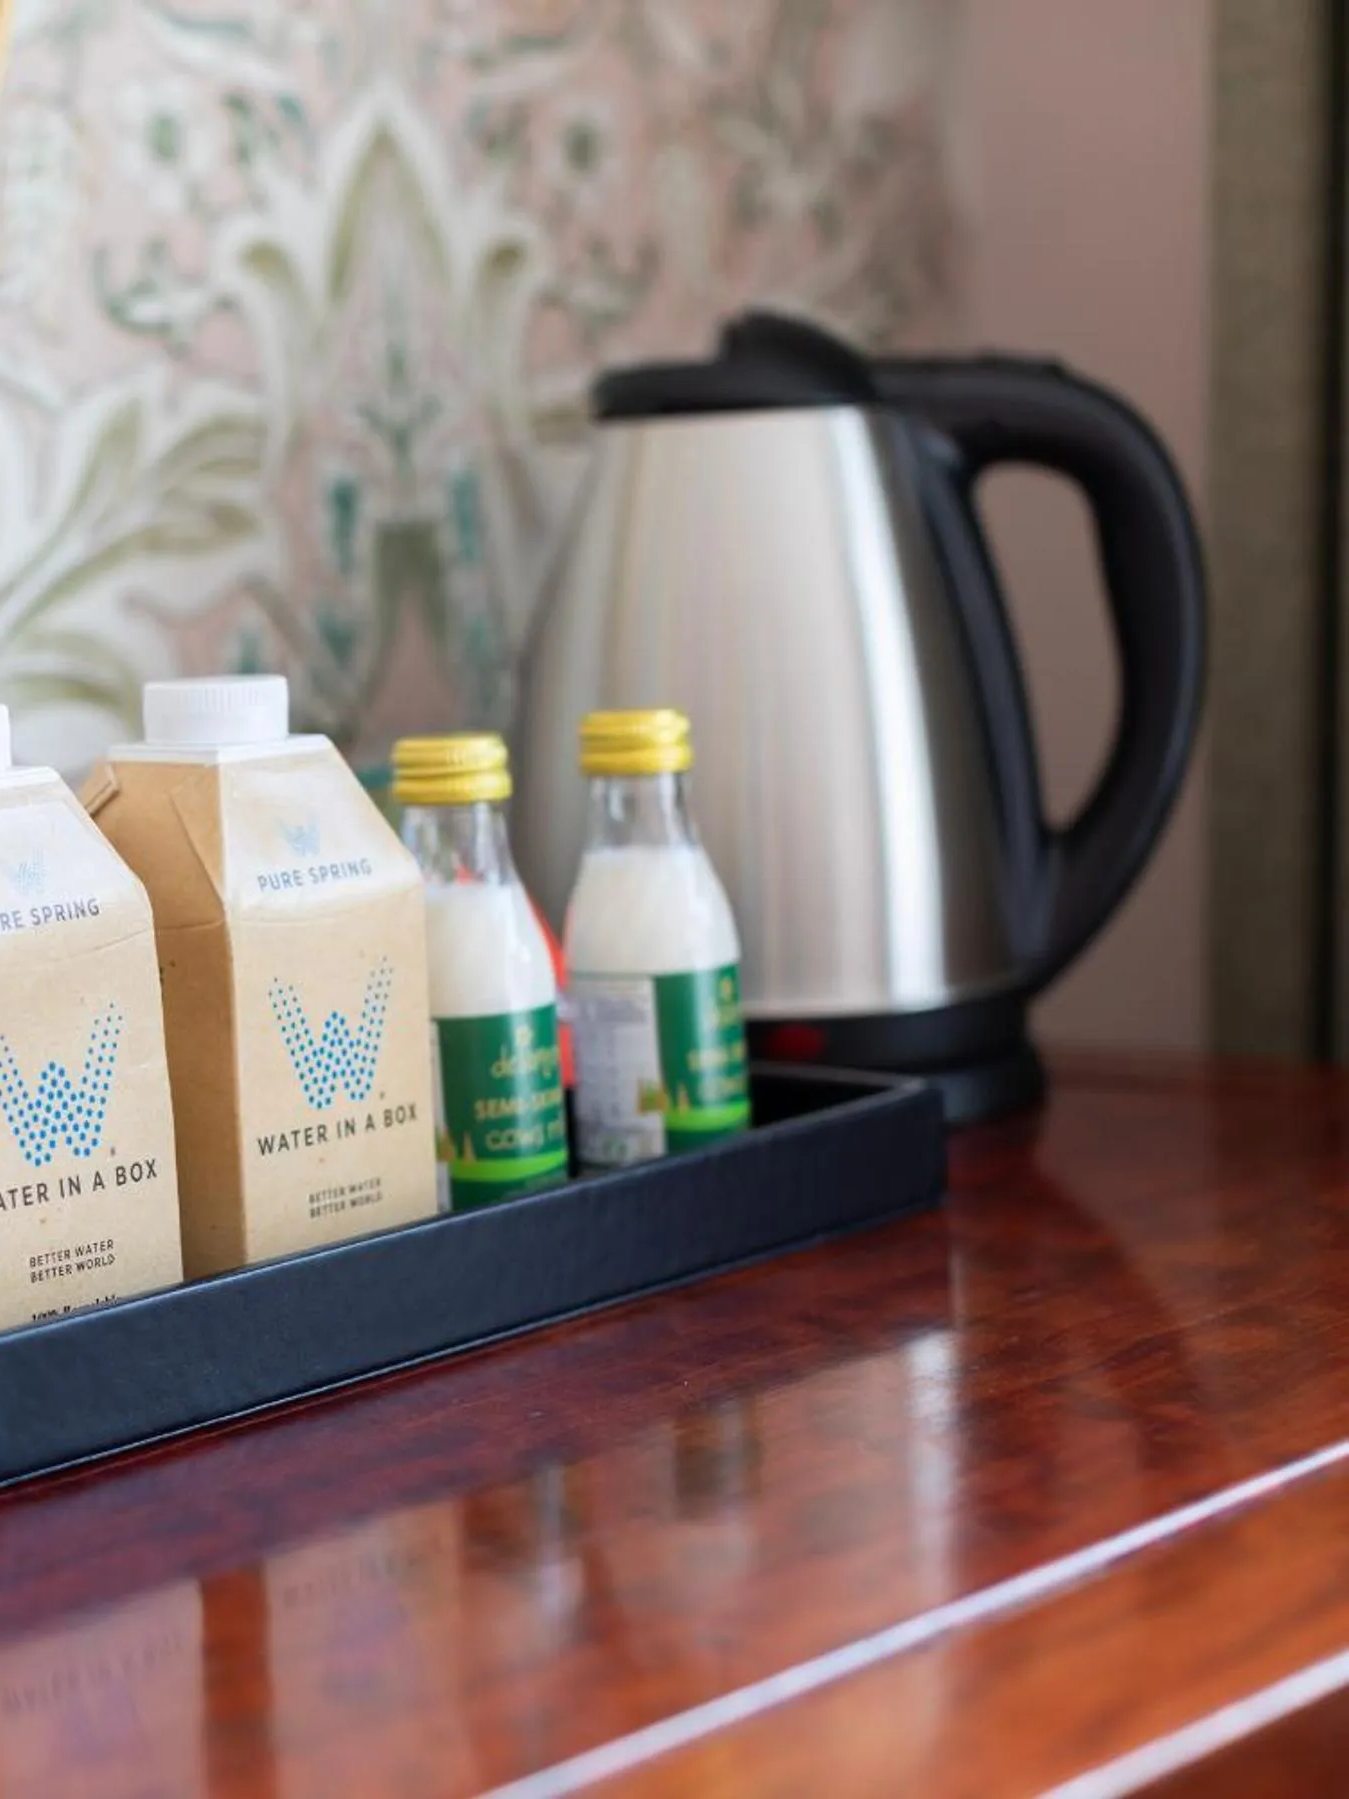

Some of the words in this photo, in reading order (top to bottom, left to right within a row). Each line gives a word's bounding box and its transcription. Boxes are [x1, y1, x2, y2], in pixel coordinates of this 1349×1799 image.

[257, 868, 304, 893] PURE
[307, 858, 373, 884] SPRING
[29, 898, 101, 927] SPRING
[258, 1123, 328, 1157] WATER
[337, 1118, 357, 1139] IN
[364, 1114, 376, 1132] A
[384, 1103, 419, 1130] BOX
[59, 1176, 83, 1200] IN
[92, 1174, 106, 1192] A
[115, 1158, 159, 1187] BOX
[309, 1186, 346, 1204] BETTER
[349, 1177, 381, 1193] WATER
[310, 1200, 346, 1219] BETTER
[350, 1191, 383, 1208] WORLD
[29, 1248, 71, 1268] BETTER
[75, 1239, 114, 1257] WATER
[30, 1264, 72, 1283] BETTER
[75, 1253, 116, 1272] WORLD
